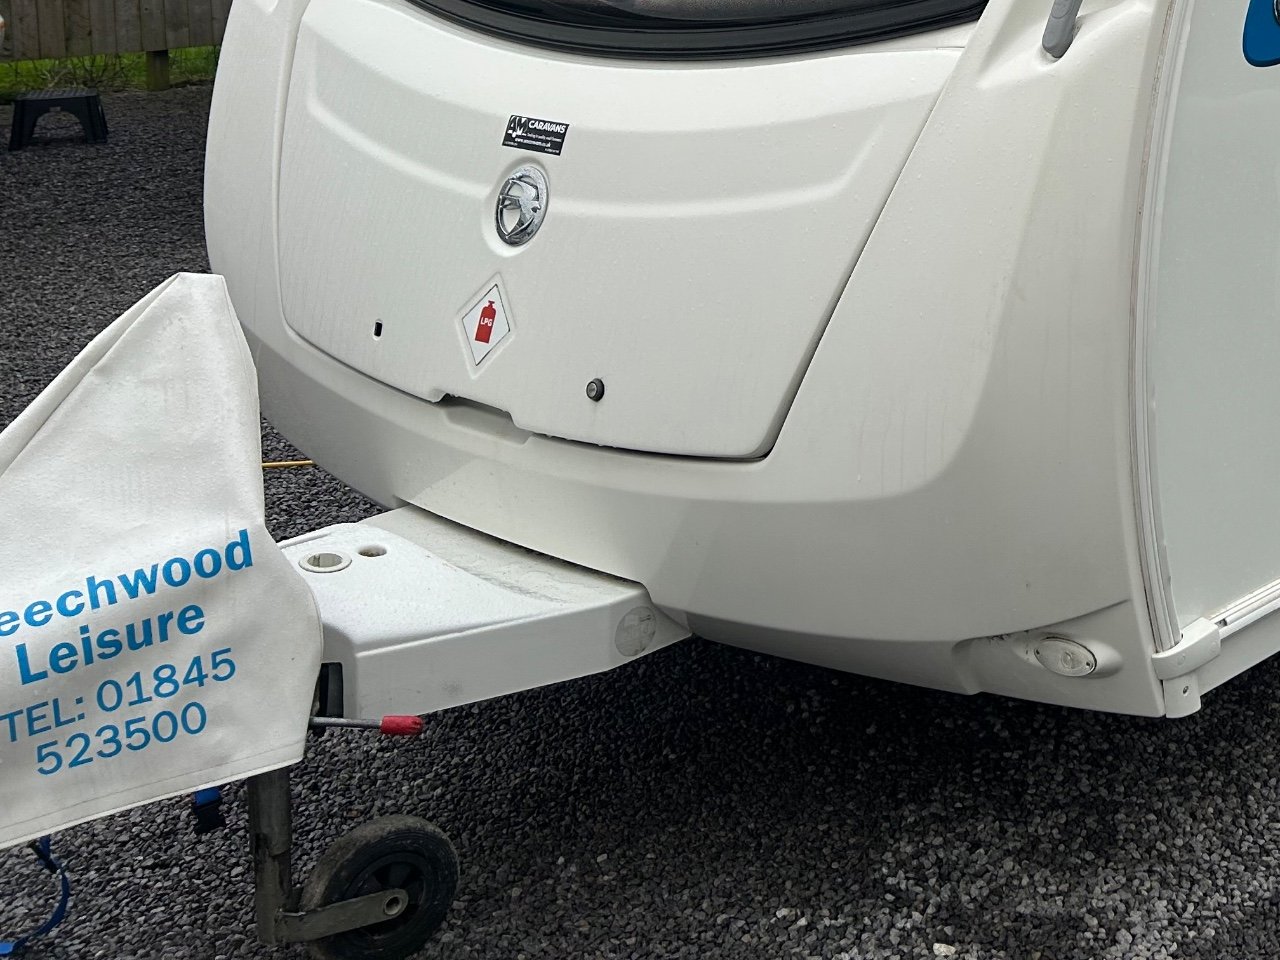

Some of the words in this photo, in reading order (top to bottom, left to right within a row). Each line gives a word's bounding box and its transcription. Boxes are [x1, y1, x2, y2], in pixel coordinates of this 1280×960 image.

[528, 120, 567, 134] CARAVANS
[480, 316, 493, 327] LPG
[15, 604, 206, 686] Leisure
[0, 696, 86, 743] TEL:
[96, 647, 237, 713] 01845
[36, 701, 208, 776] 523500
